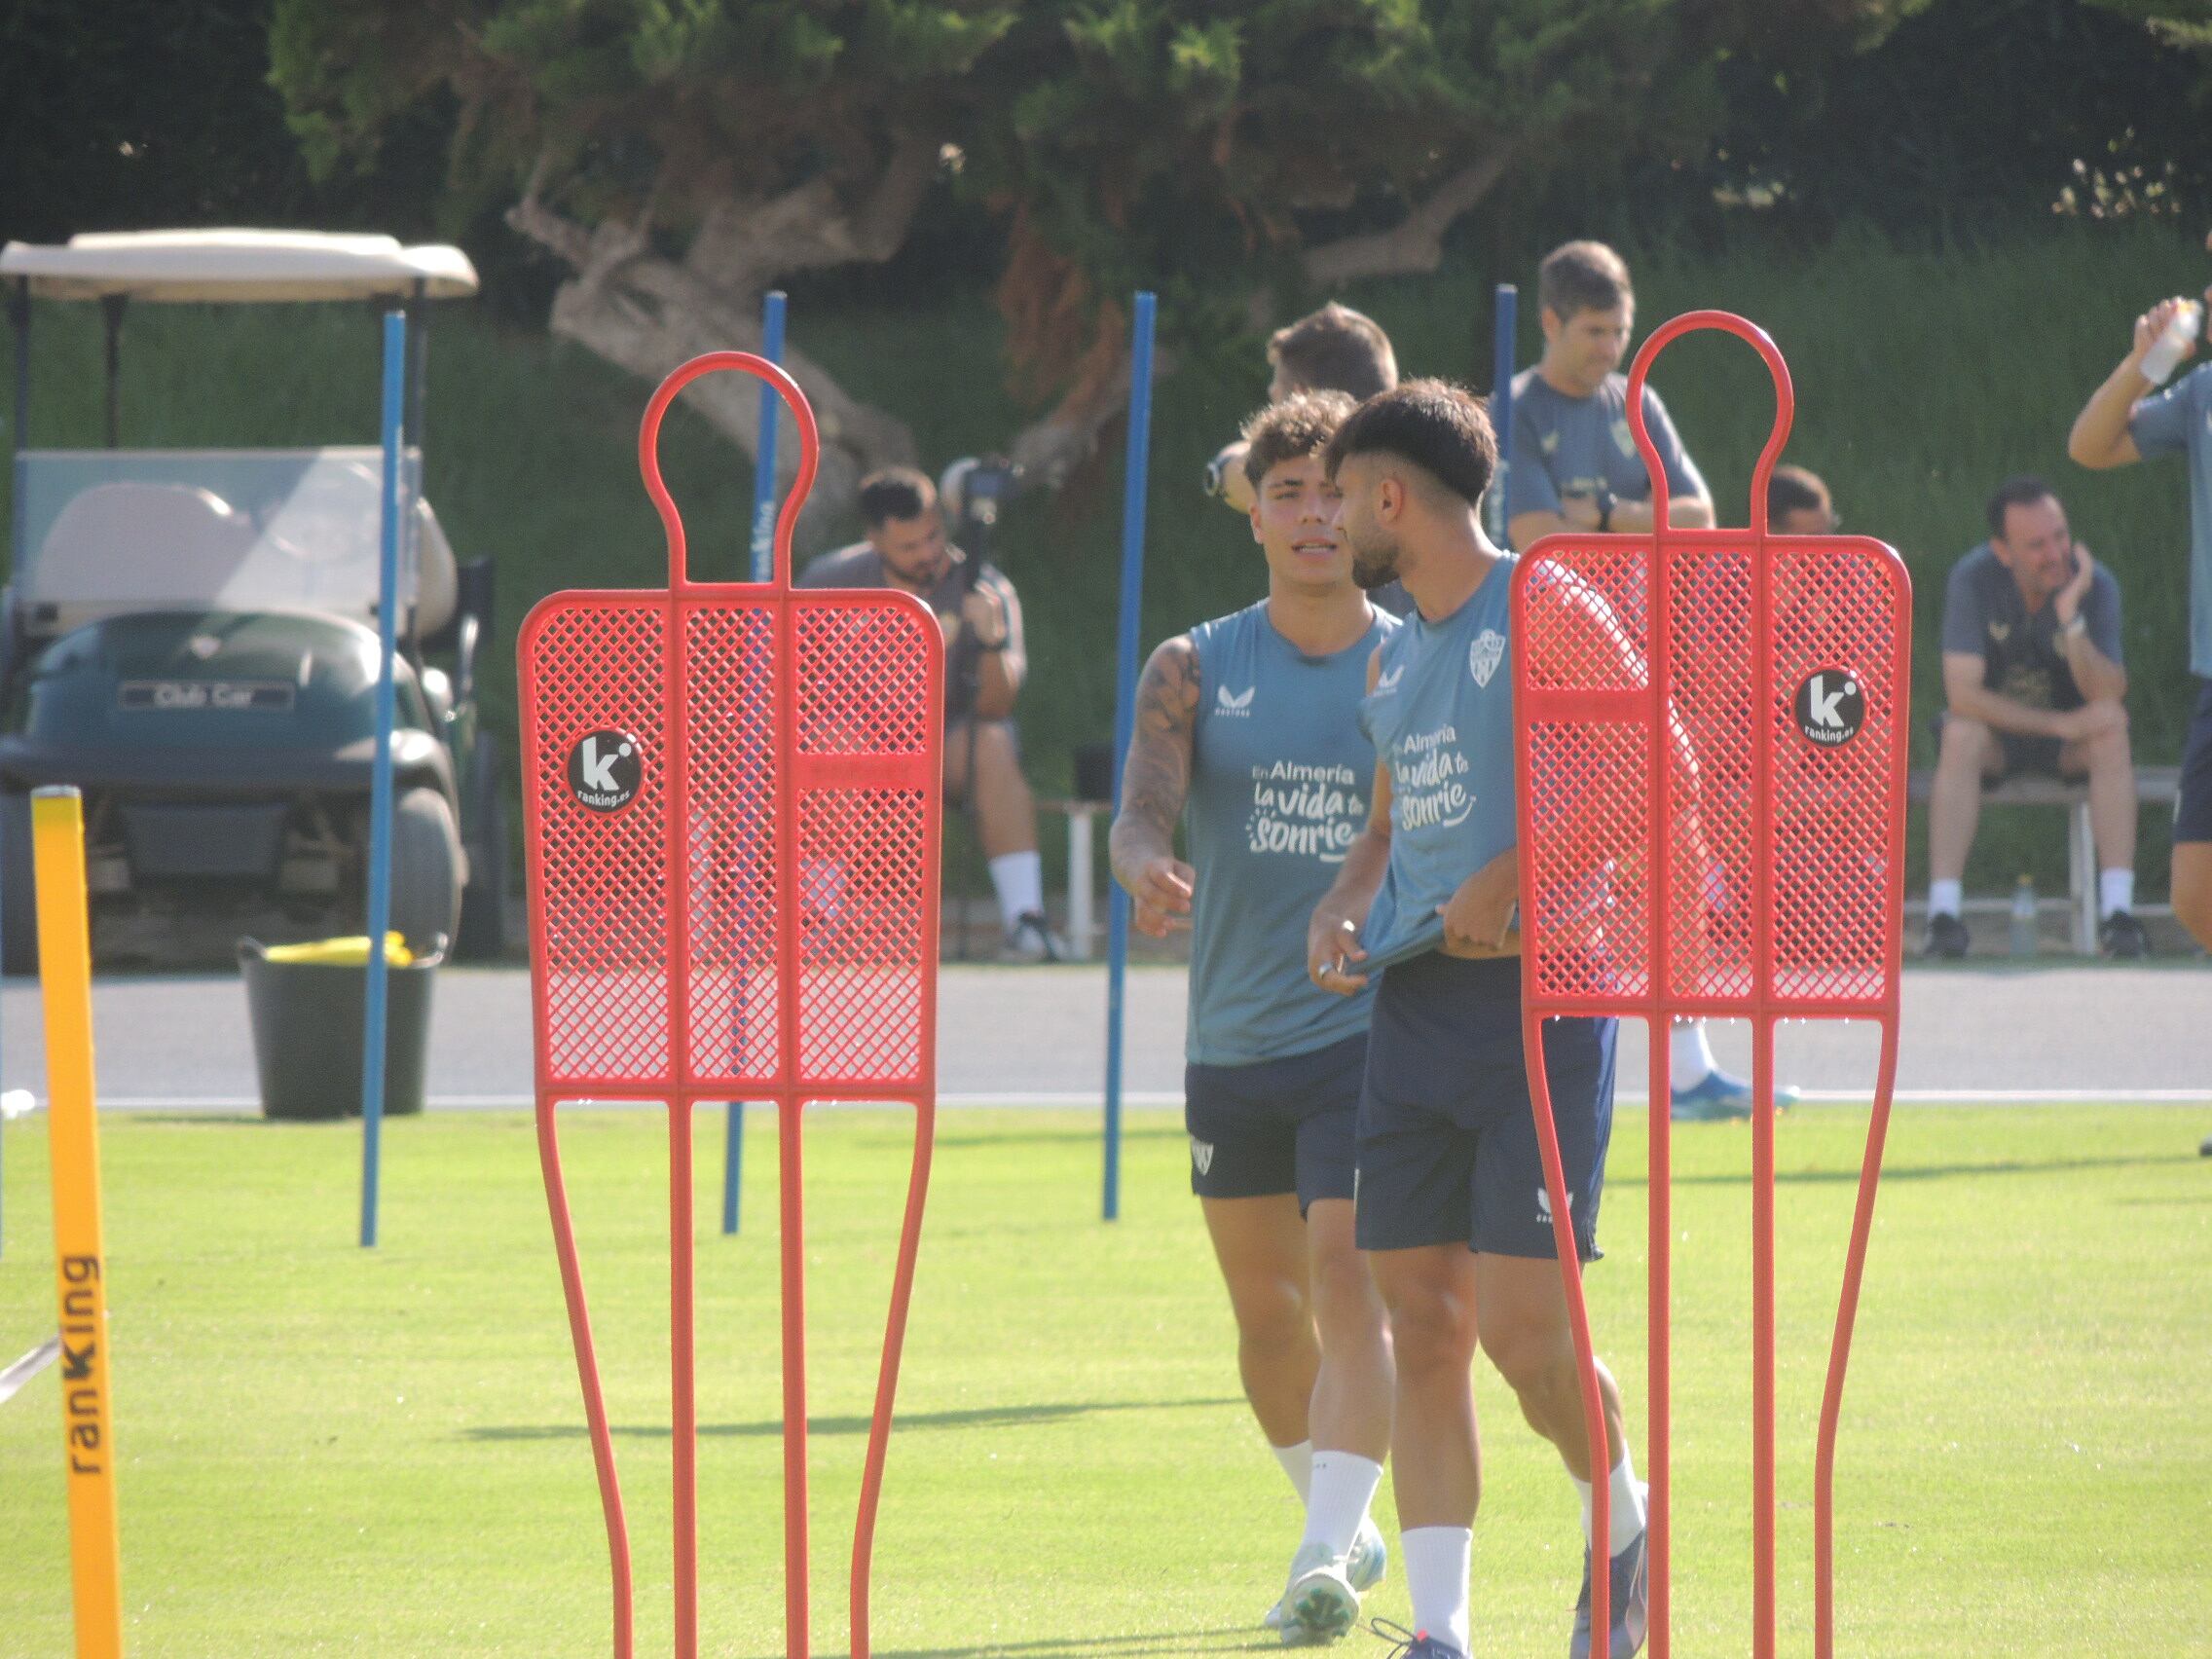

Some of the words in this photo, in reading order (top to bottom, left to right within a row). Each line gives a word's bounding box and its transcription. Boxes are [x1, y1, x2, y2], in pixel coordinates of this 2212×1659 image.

[155, 682, 207, 709] Club
[211, 682, 252, 709] Car
[577, 790, 631, 807] ranking.es
[1277, 780, 1344, 819] vida
